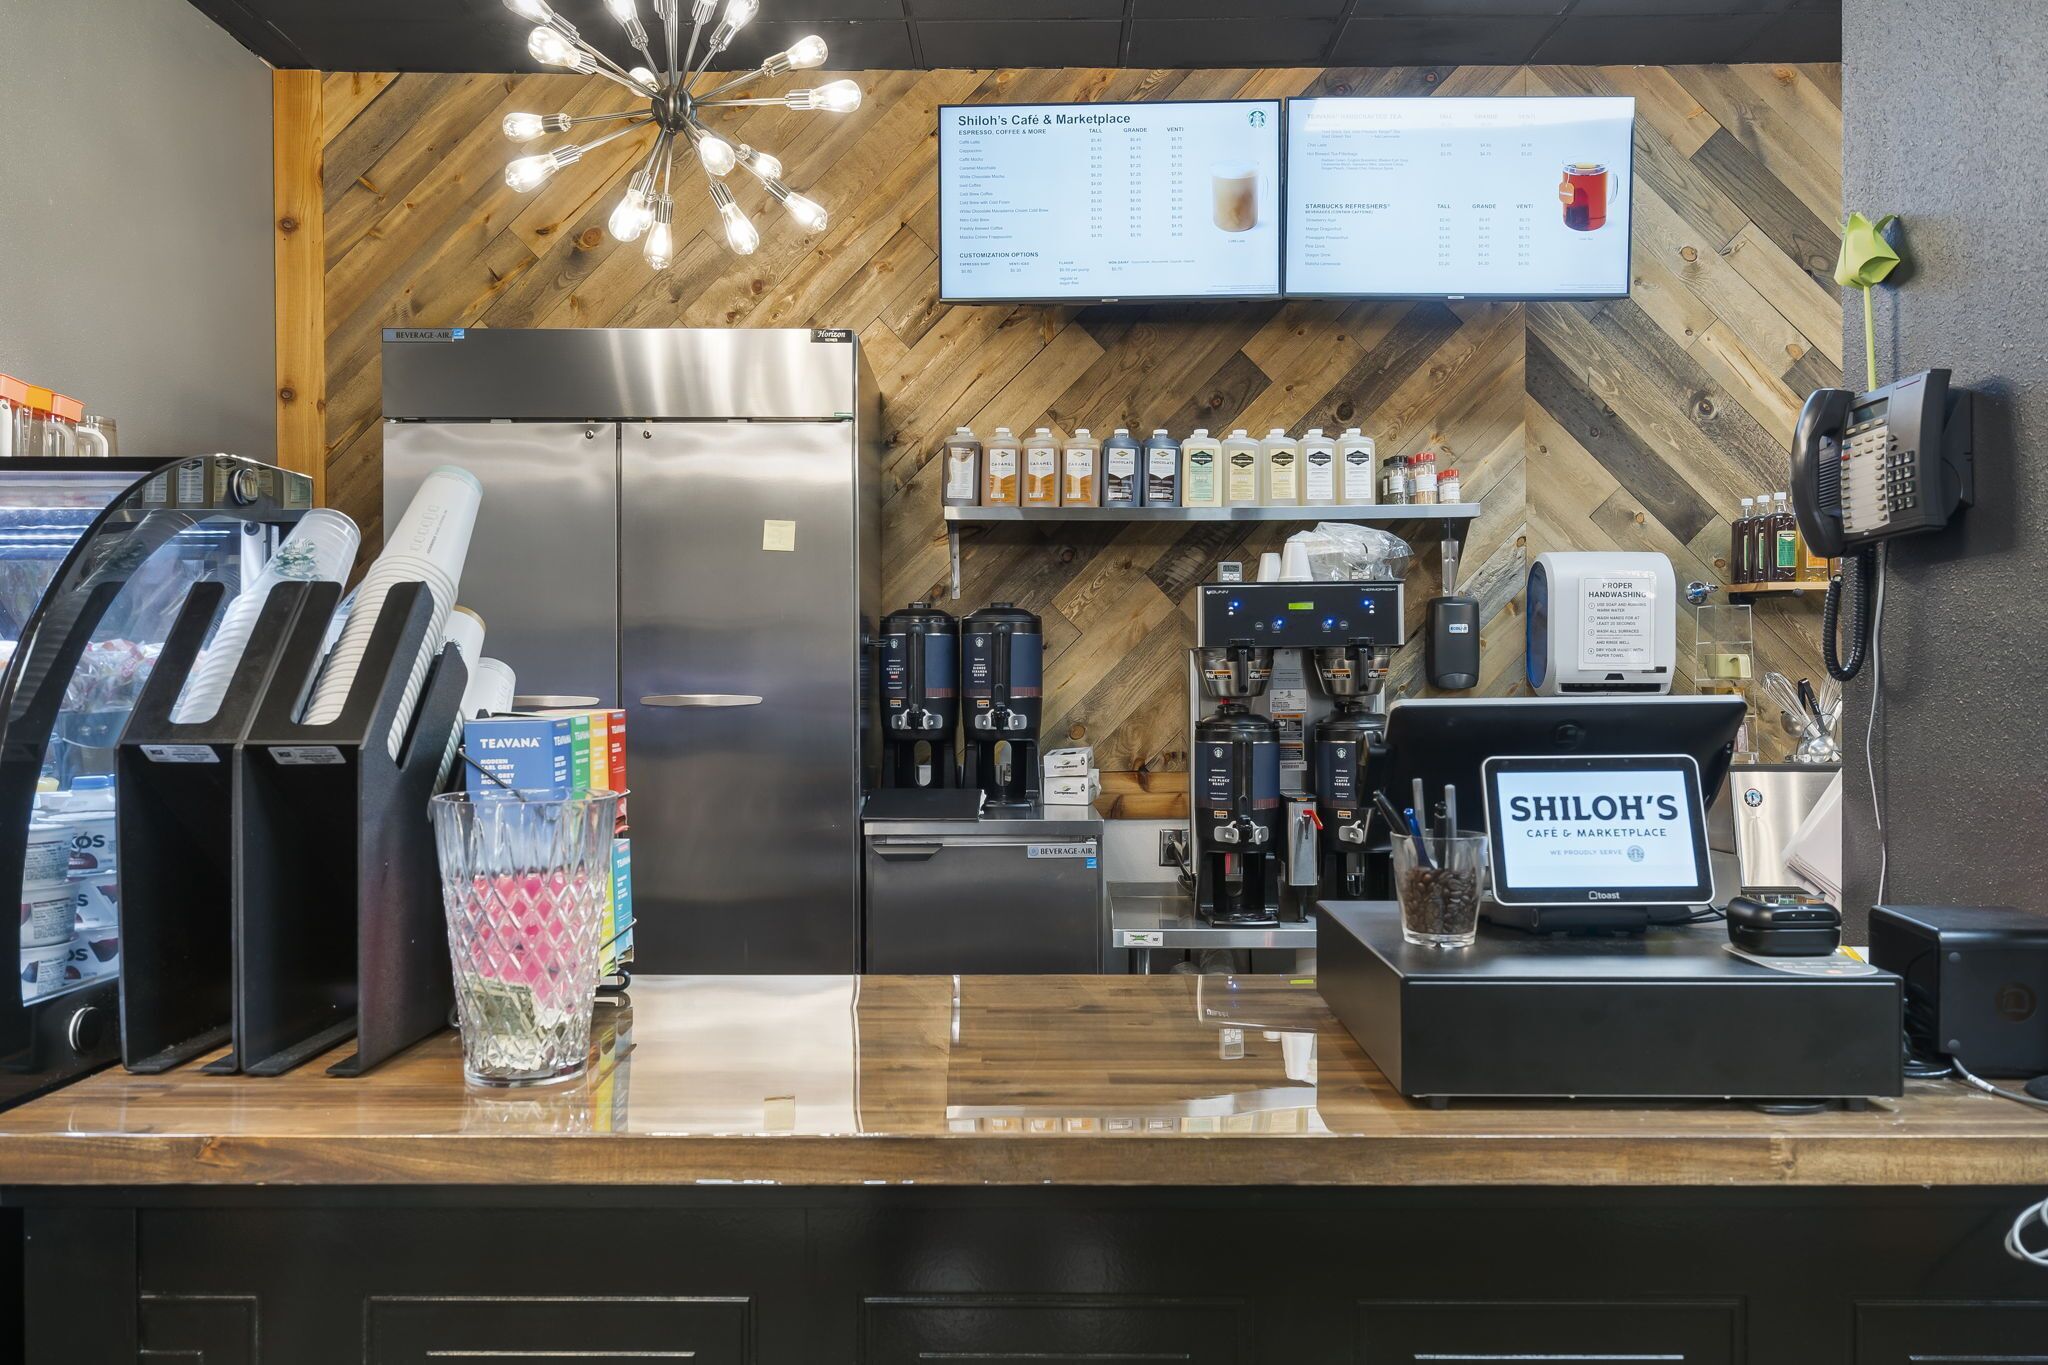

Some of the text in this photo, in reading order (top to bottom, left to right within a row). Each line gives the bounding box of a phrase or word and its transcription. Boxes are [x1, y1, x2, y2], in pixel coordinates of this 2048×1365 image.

[958, 113, 1131, 126] Shiloh's Café & Marketplace
[395, 331, 450, 339] BEVERAGE-AIR
[817, 330, 846, 338] Horizon
[1510, 794, 1679, 822] SHILOH'S
[1526, 826, 1667, 838] CAFÉ & MARKETPLACE
[1040, 847, 1095, 856] BEVERAGE-AIR
[1596, 891, 1620, 900] toast
